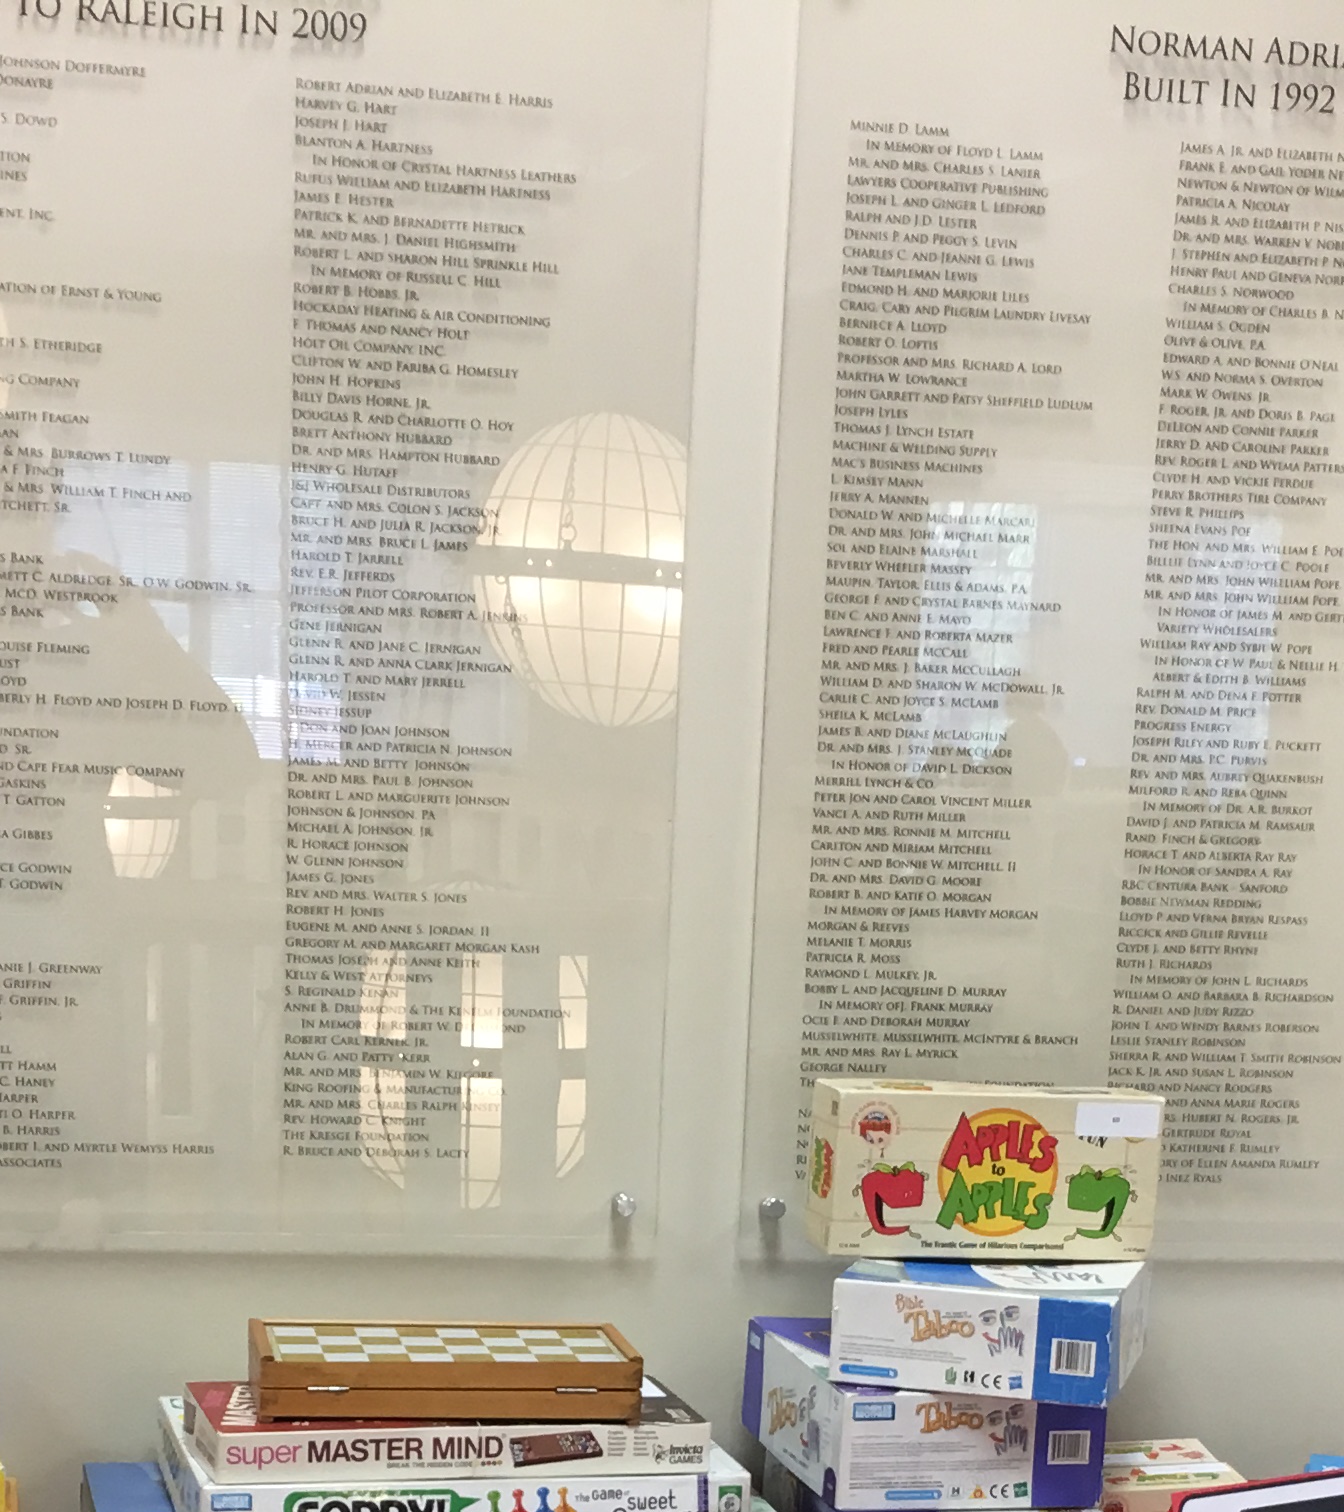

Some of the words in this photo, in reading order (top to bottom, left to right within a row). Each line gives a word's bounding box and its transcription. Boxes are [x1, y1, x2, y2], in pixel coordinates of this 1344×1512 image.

[77, 0, 225, 33] RALEIGH
[241, 4, 278, 35] IN
[292, 8, 368, 42] 2009
[1109, 24, 1253, 62] NORMAN
[1122, 71, 1210, 106] BUILT
[1221, 78, 1257, 108] IN
[1270, 82, 1336, 115] 1992
[915, 124, 950, 137] LAMM
[991, 1162, 1006, 1176] to
[904, 1310, 976, 1343] Taboo
[915, 1401, 984, 1433] Taboo
[226, 1443, 303, 1469] super
[307, 1437, 424, 1464] MASTER
[431, 1436, 504, 1460] MIND
[627, 1488, 678, 1511] sweet
